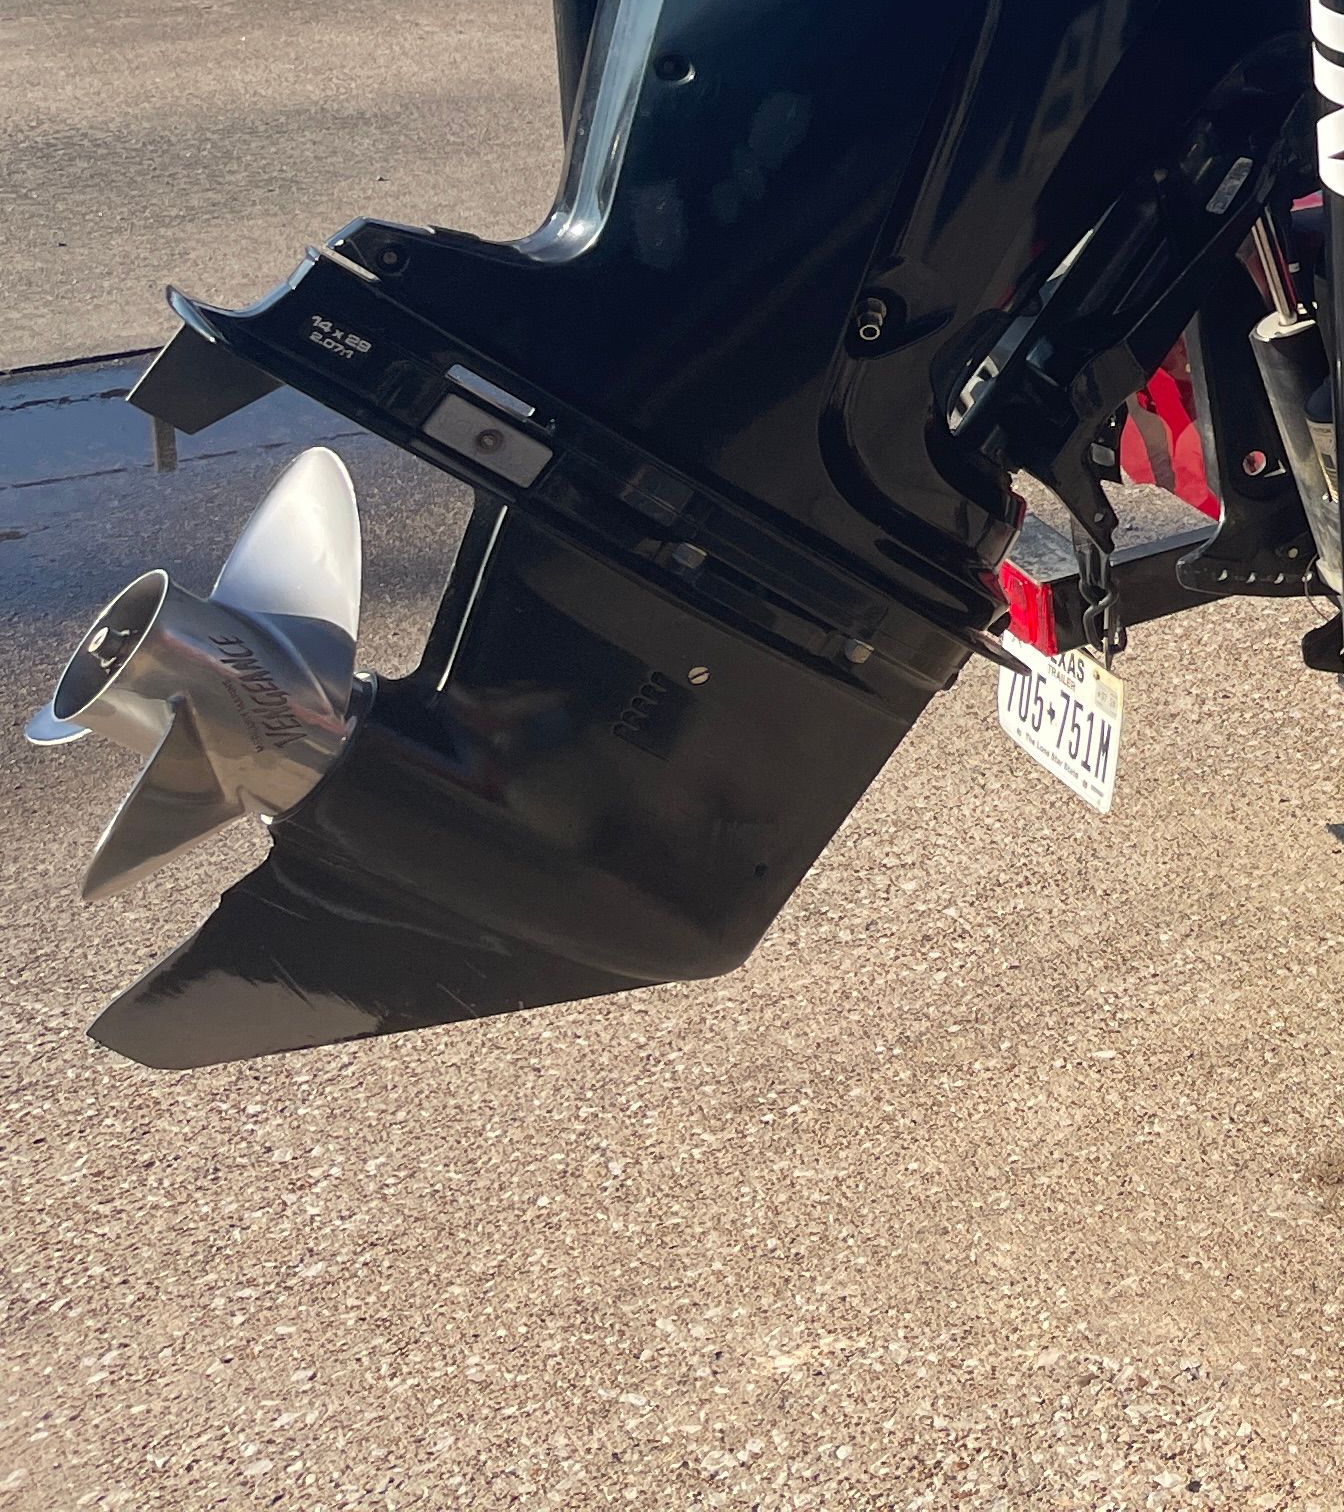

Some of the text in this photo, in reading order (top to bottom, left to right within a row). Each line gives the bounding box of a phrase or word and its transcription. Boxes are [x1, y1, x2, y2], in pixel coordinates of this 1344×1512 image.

[311, 315, 333, 333] 14
[344, 333, 372, 353] 29
[207, 635, 308, 748] VENGEANCE
[1050, 652, 1085, 684] XAS
[1056, 689, 1112, 784] 751M
